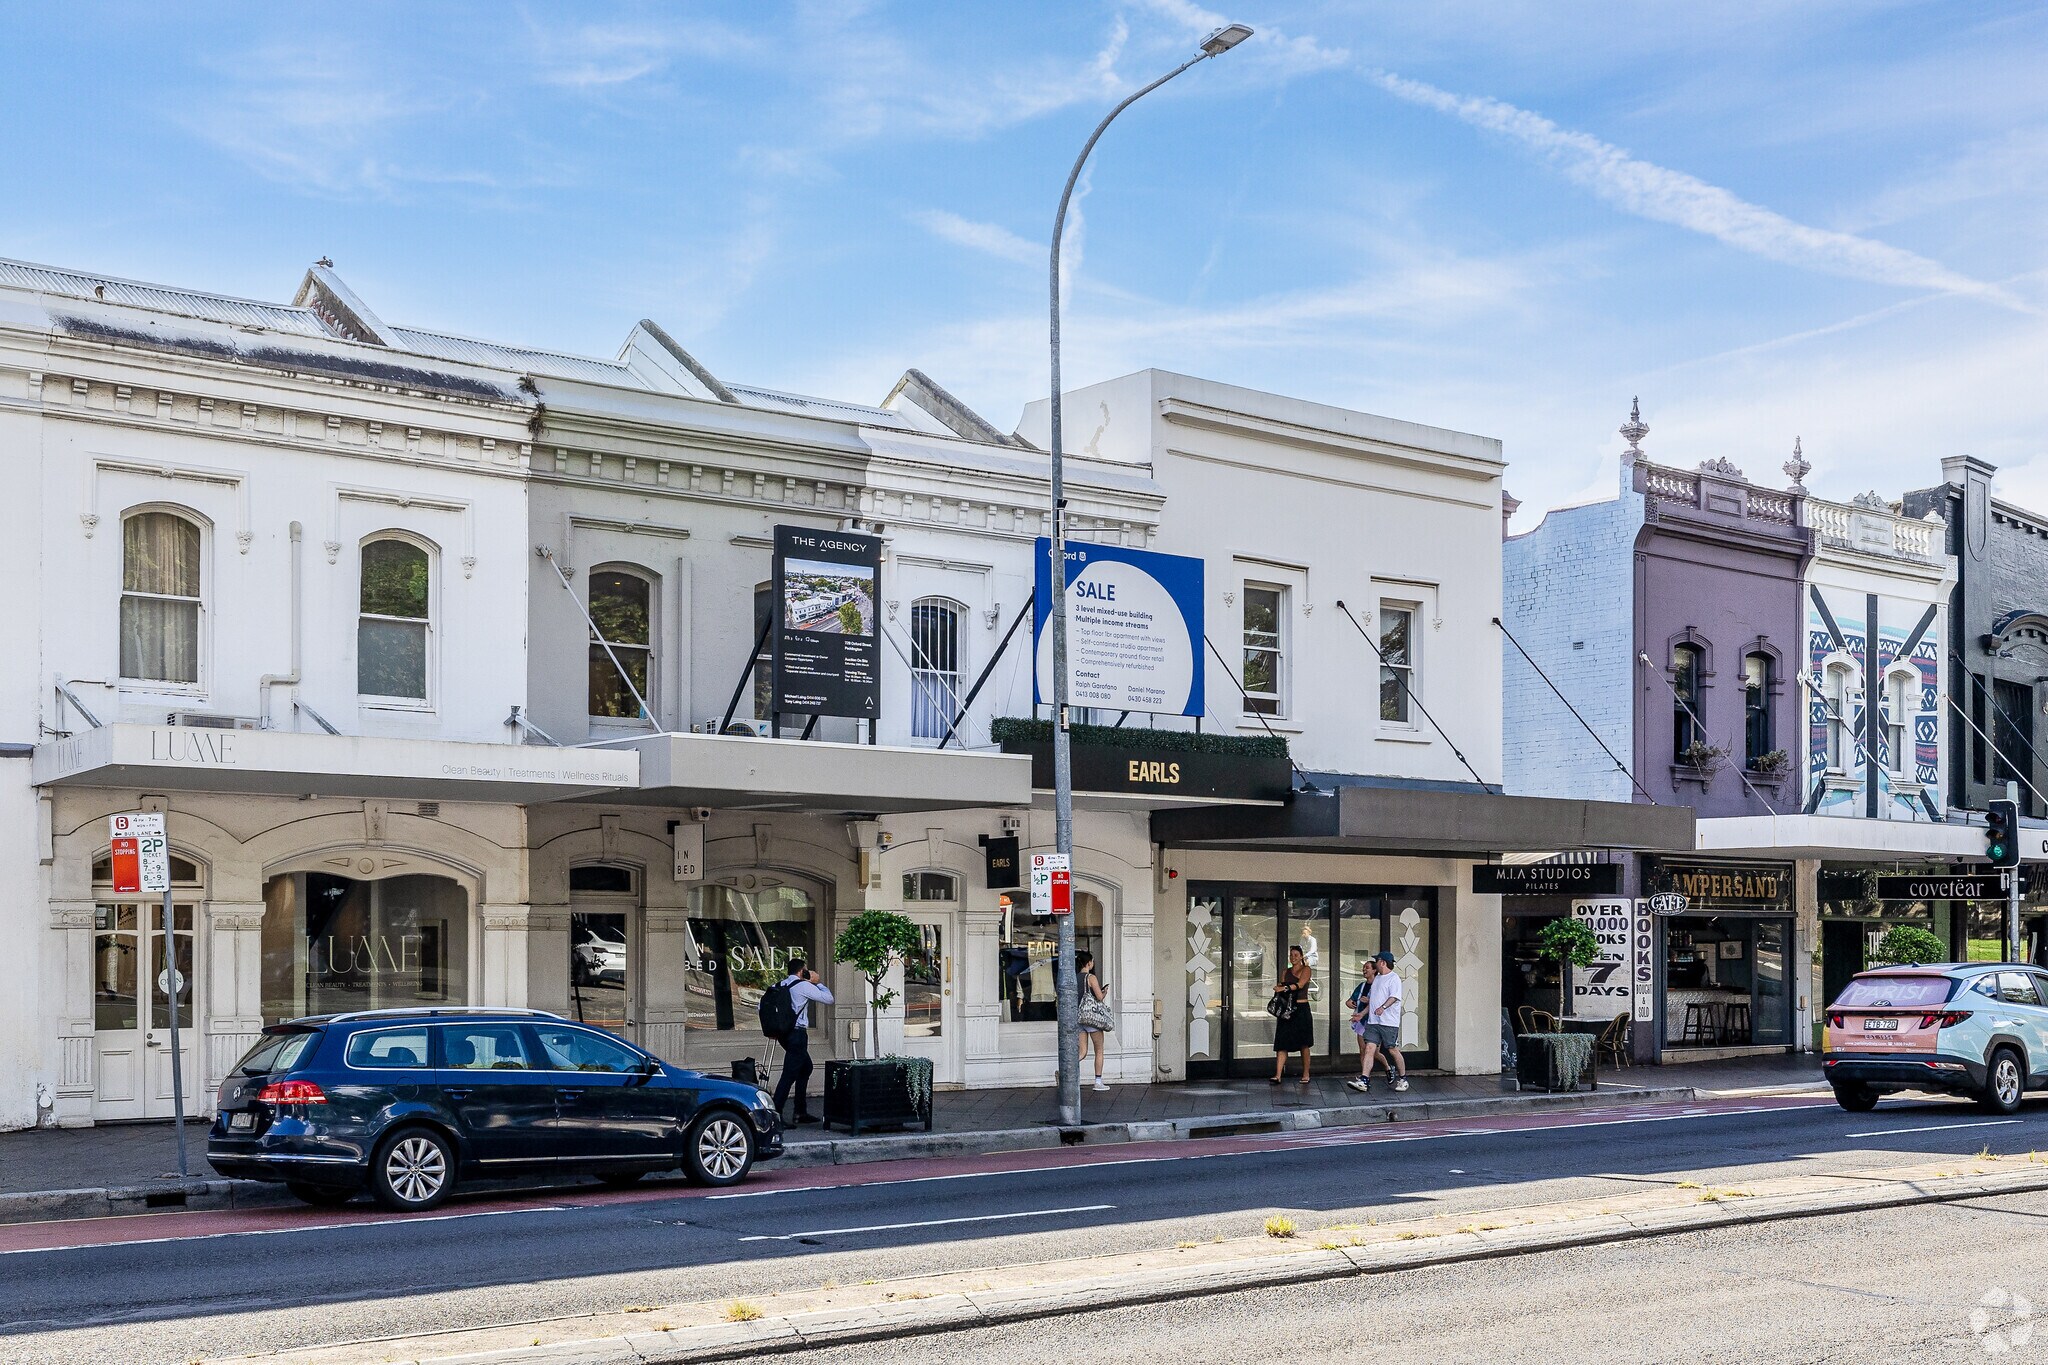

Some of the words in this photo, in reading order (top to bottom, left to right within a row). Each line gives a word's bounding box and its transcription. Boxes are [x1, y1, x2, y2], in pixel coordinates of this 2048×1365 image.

[792, 536, 816, 546] THE
[820, 540, 867, 552] AGENCY
[1076, 580, 1115, 601] SALE
[1076, 604, 1080, 612] 3
[1080, 605, 1095, 613] level
[1097, 607, 1128, 617] mixed-use
[1129, 610, 1152, 621] building
[1076, 615, 1101, 626] Multiple
[1102, 618, 1124, 627] income
[1126, 620, 1148, 630] streams
[1081, 628, 1090, 636] Top
[1113, 632, 1140, 640] apartment
[1081, 638, 1119, 648] Self-contained
[1081, 648, 1118, 658] Contemporary
[1081, 658, 1124, 669] Comprehensively
[1126, 663, 1154, 671] refurbished
[1076, 670, 1100, 678] Contact
[442, 764, 467, 775] Clean
[470, 765, 501, 778] Beauty
[509, 767, 556, 778] Treatments
[562, 770, 599, 781] Wellness
[602, 771, 628, 782] Rituals
[1129, 760, 1180, 783] EARLS
[142, 839, 163, 852] 2P
[678, 850, 688, 859] IN
[992, 858, 1010, 868] EARLS
[678, 866, 695, 874] BED
[1496, 868, 1526, 880] M.I.A
[1530, 868, 1591, 879] STUDIOS
[1672, 873, 1777, 899] AMPERSAND
[1909, 879, 1984, 896] covetëar
[1577, 905, 1623, 916] OVER
[1576, 917, 1629, 931] 0,000
[1596, 934, 1626, 944] OKS
[1636, 903, 1651, 982] BOOKS
[1028, 942, 1059, 956] EARL
[1583, 963, 1621, 986] 7
[1574, 986, 1629, 996] DAYS
[1636, 984, 1652, 994] BOUGHT
[1638, 1006, 1649, 1017] SOLD
